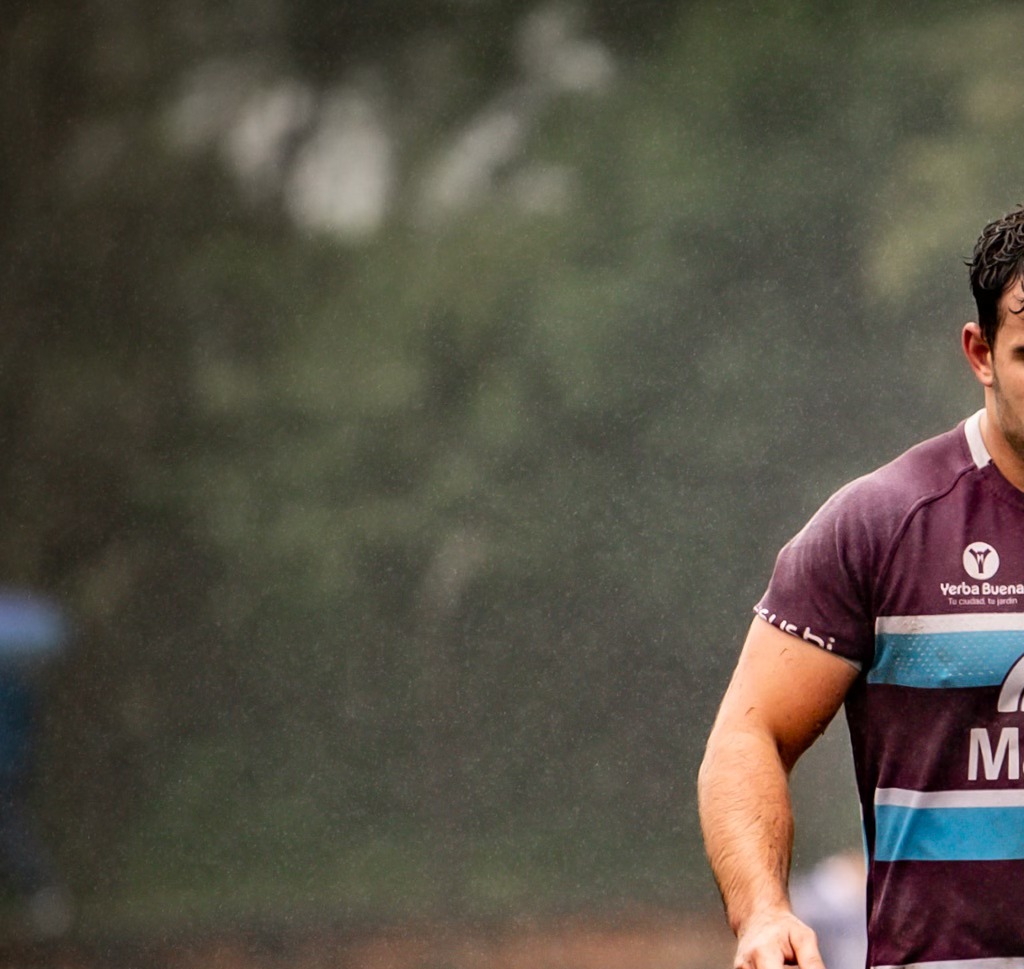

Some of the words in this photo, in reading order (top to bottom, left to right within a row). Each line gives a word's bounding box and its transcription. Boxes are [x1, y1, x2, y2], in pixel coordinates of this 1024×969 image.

[940, 582, 980, 596] Yerba
[981, 582, 1024, 596] Buena
[948, 597, 957, 605] Tu
[987, 597, 996, 605] tu
